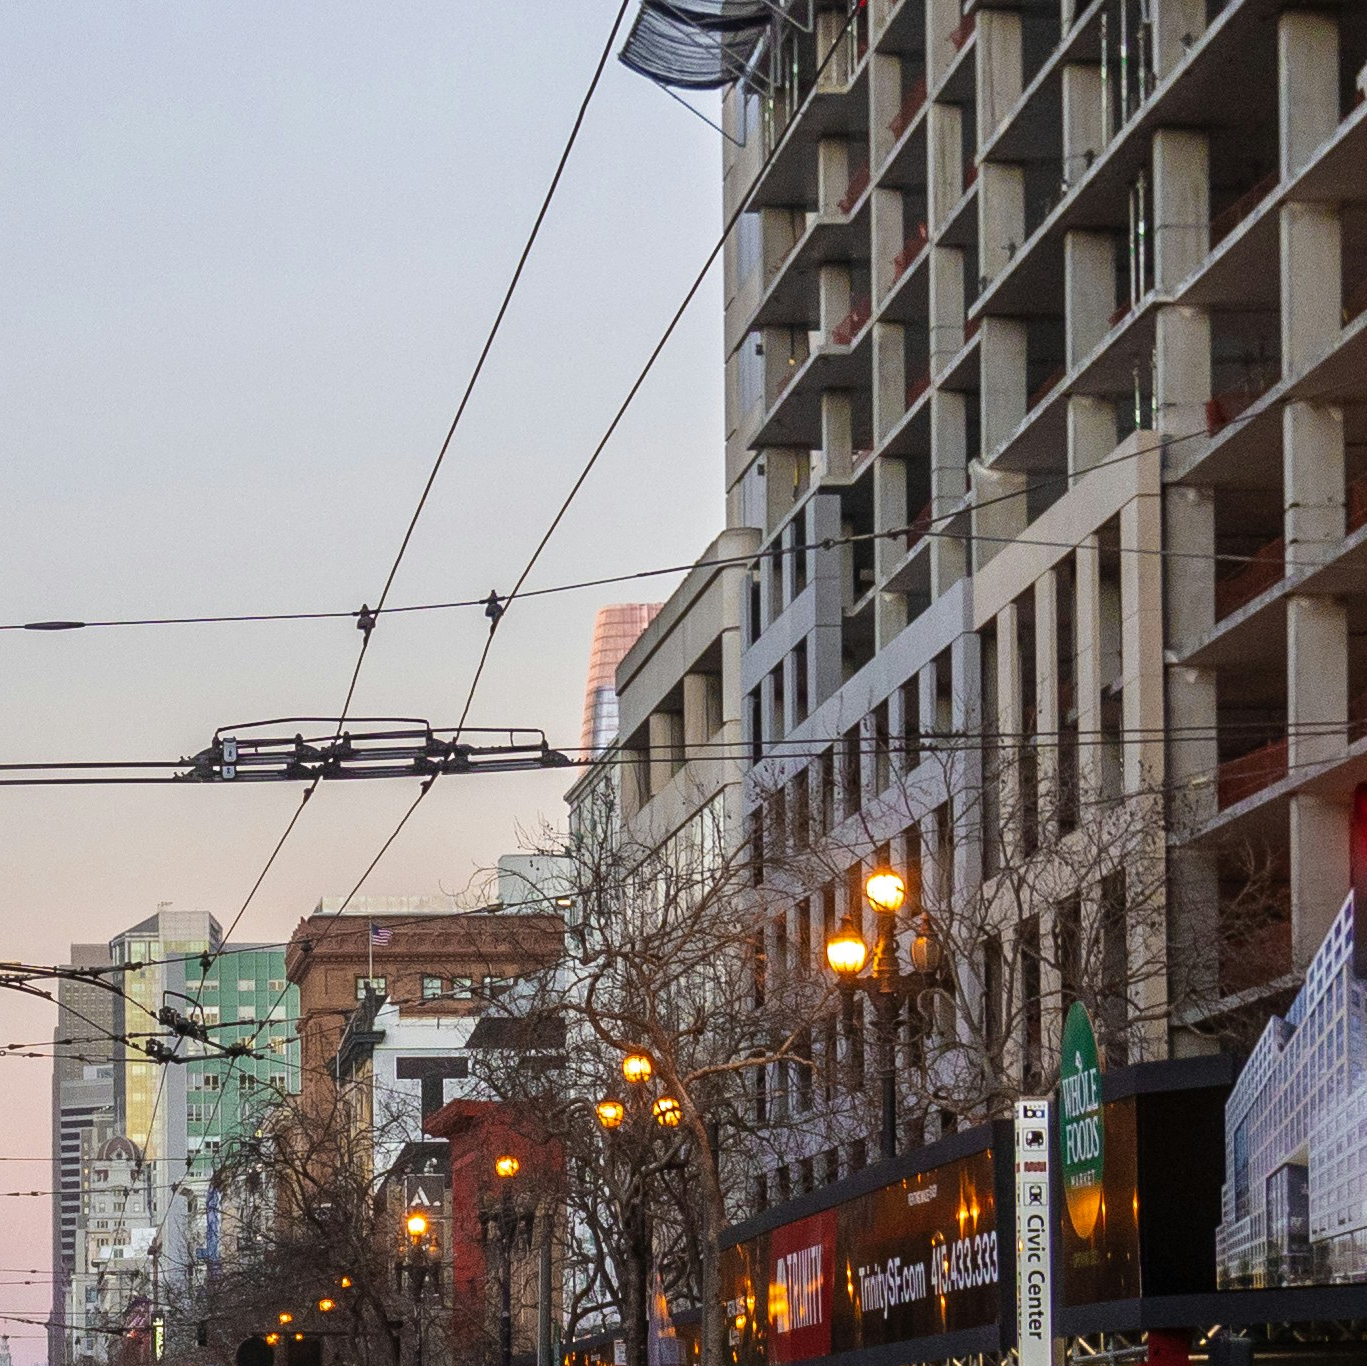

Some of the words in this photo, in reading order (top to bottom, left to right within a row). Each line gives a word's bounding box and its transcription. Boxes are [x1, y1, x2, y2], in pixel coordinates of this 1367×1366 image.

[1062, 1068, 1099, 1119] WHOLE
[1065, 1116, 1100, 1165] FOODS
[1071, 1169, 1096, 1188] MARKET
[1027, 1214, 1045, 1262] Civic
[786, 1243, 822, 1329] TRINITY
[858, 1257, 926, 1319] TrinitySF.com
[1027, 1270, 1045, 1340] Center
